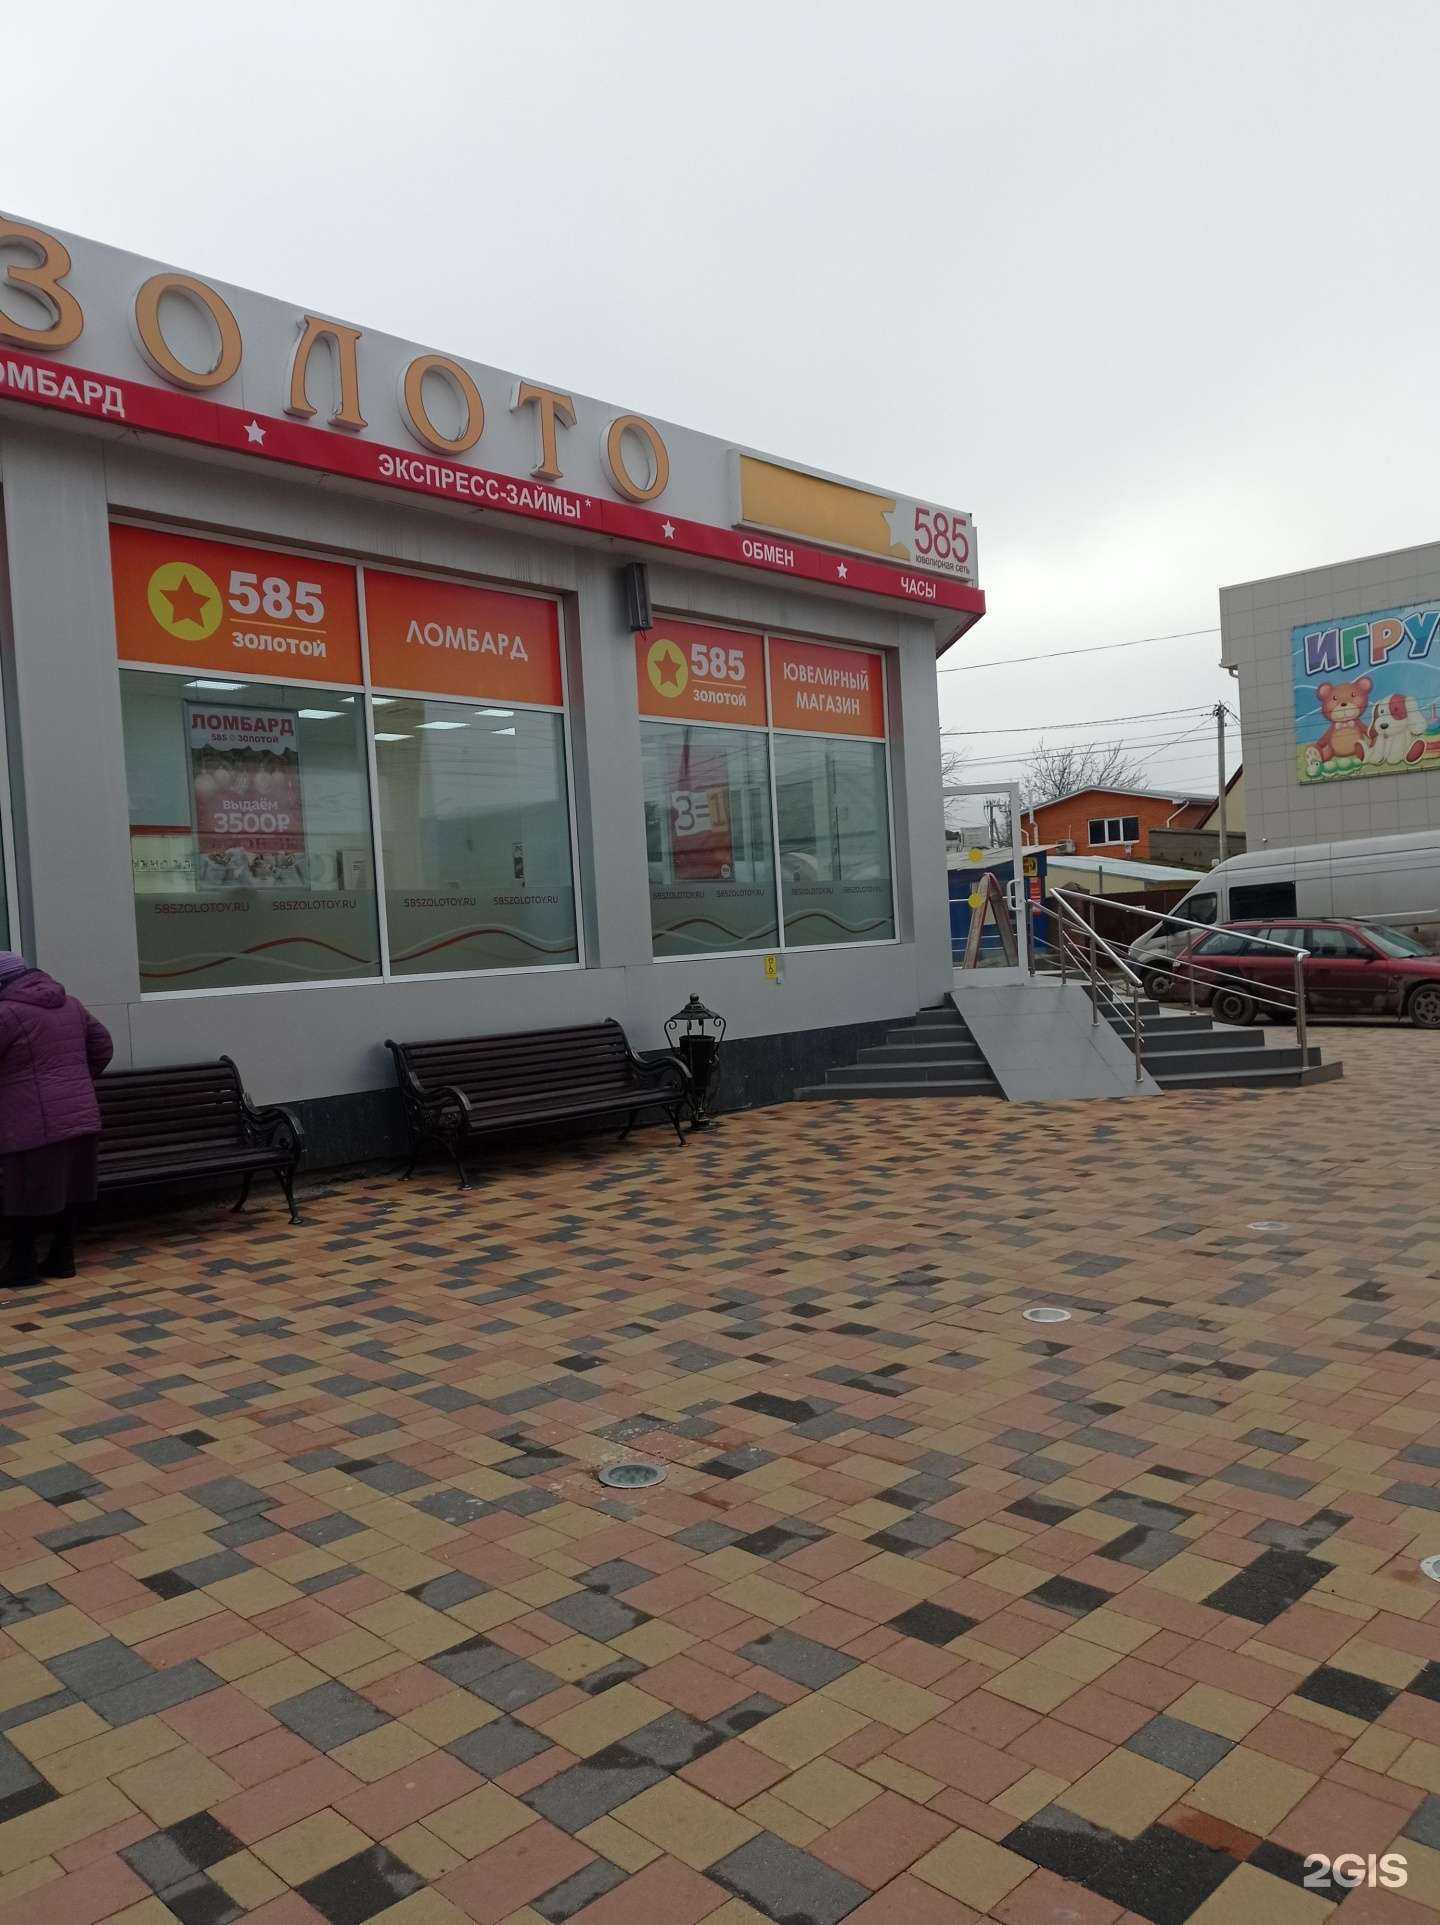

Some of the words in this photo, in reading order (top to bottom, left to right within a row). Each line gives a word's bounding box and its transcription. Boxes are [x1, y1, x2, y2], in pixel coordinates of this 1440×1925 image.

[0, 216, 671, 503] ЗОЛОТО
[0, 360, 126, 418] МБАРД
[378, 453, 581, 519] ЭКСПРЕСС-ЗАЙМЫ
[914, 507, 969, 563] 585
[742, 540, 794, 567] ОБМЕН
[915, 554, 954, 571] ювелирная
[955, 564, 970, 575] сеть
[228, 570, 325, 624] 585
[901, 577, 936, 598] ЧАСЫ
[406, 620, 528, 662] ЛОМБАРД
[691, 643, 745, 681] 585
[783, 662, 869, 691] ЮВЕЛИРНЫЙ
[796, 691, 860, 716] МАГАЗИН
[192, 713, 294, 736] ЛОМБАРД
[154, 901, 249, 914] 585ZOLOTOY.RU
[272, 899, 357, 911] 585ZOLOTOY.RU
